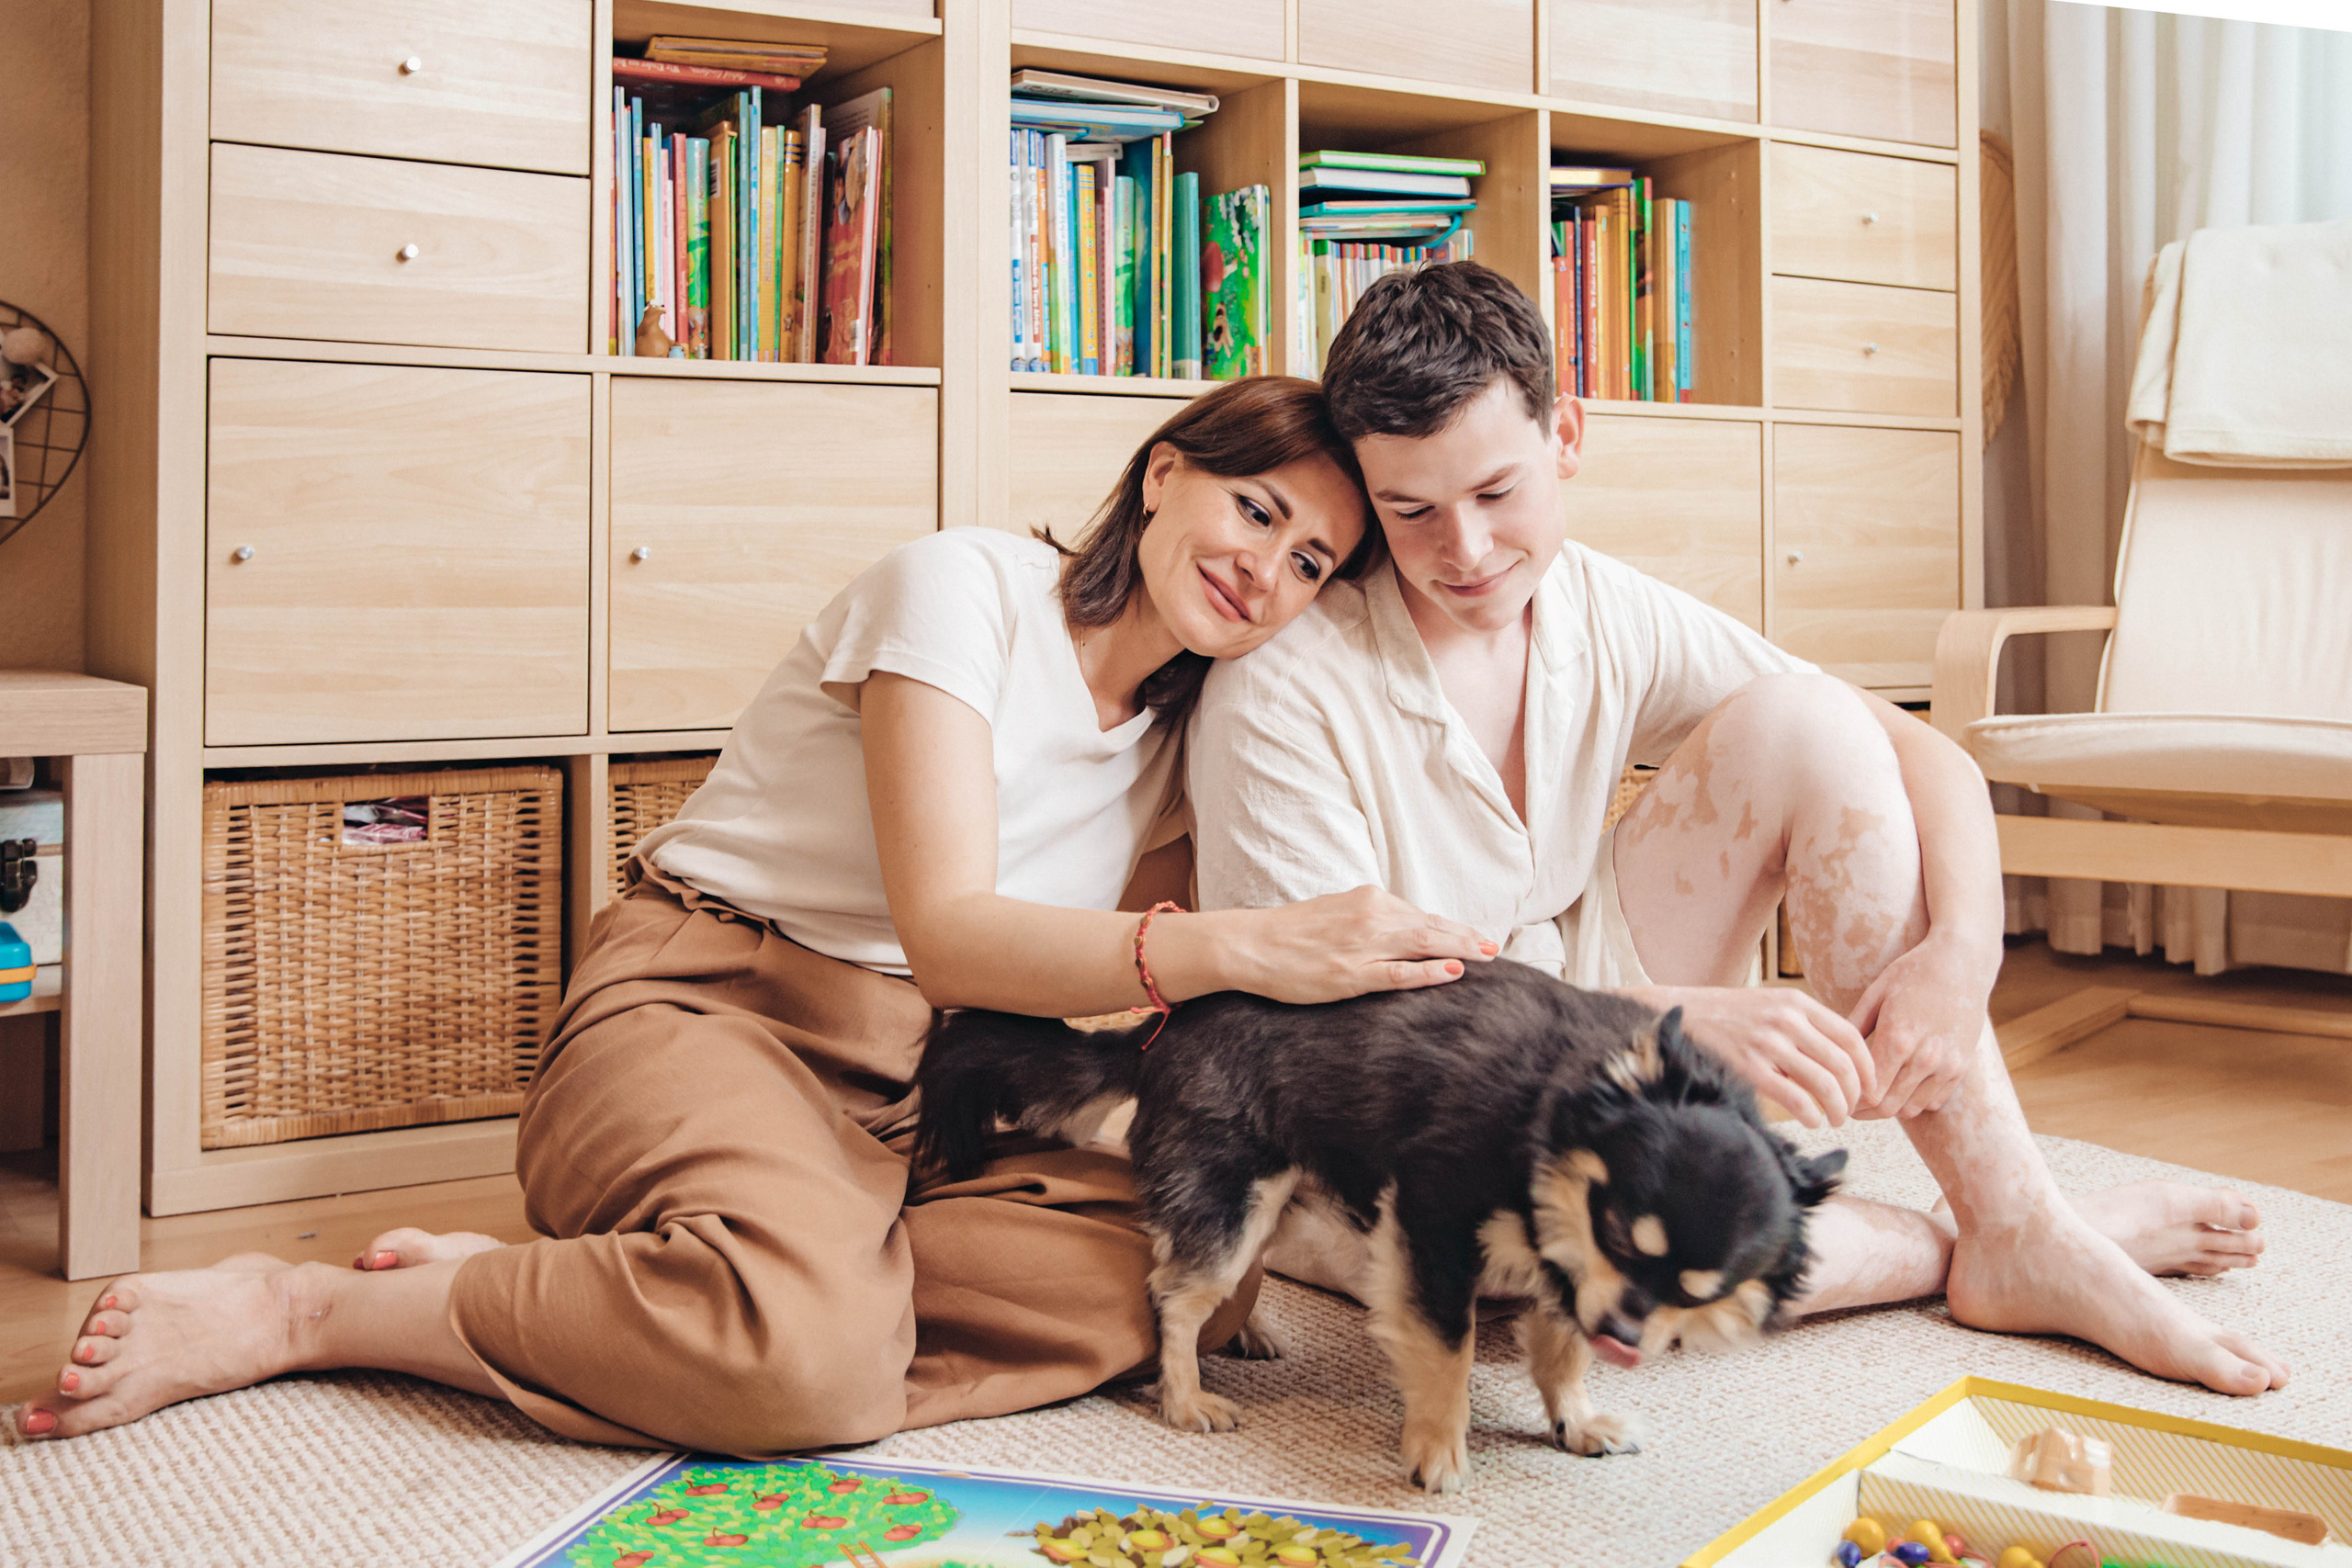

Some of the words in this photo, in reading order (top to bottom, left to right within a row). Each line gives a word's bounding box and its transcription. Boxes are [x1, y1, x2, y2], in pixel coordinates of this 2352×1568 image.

[641, 61, 664, 72] Kinder
[665, 64, 680, 74] Wir
[1057, 149, 1066, 198] Jahreszeiten
[1032, 289, 1040, 308] Tiere
[1013, 306, 1022, 335] Englisch
[1033, 309, 1041, 335] Afrikas
